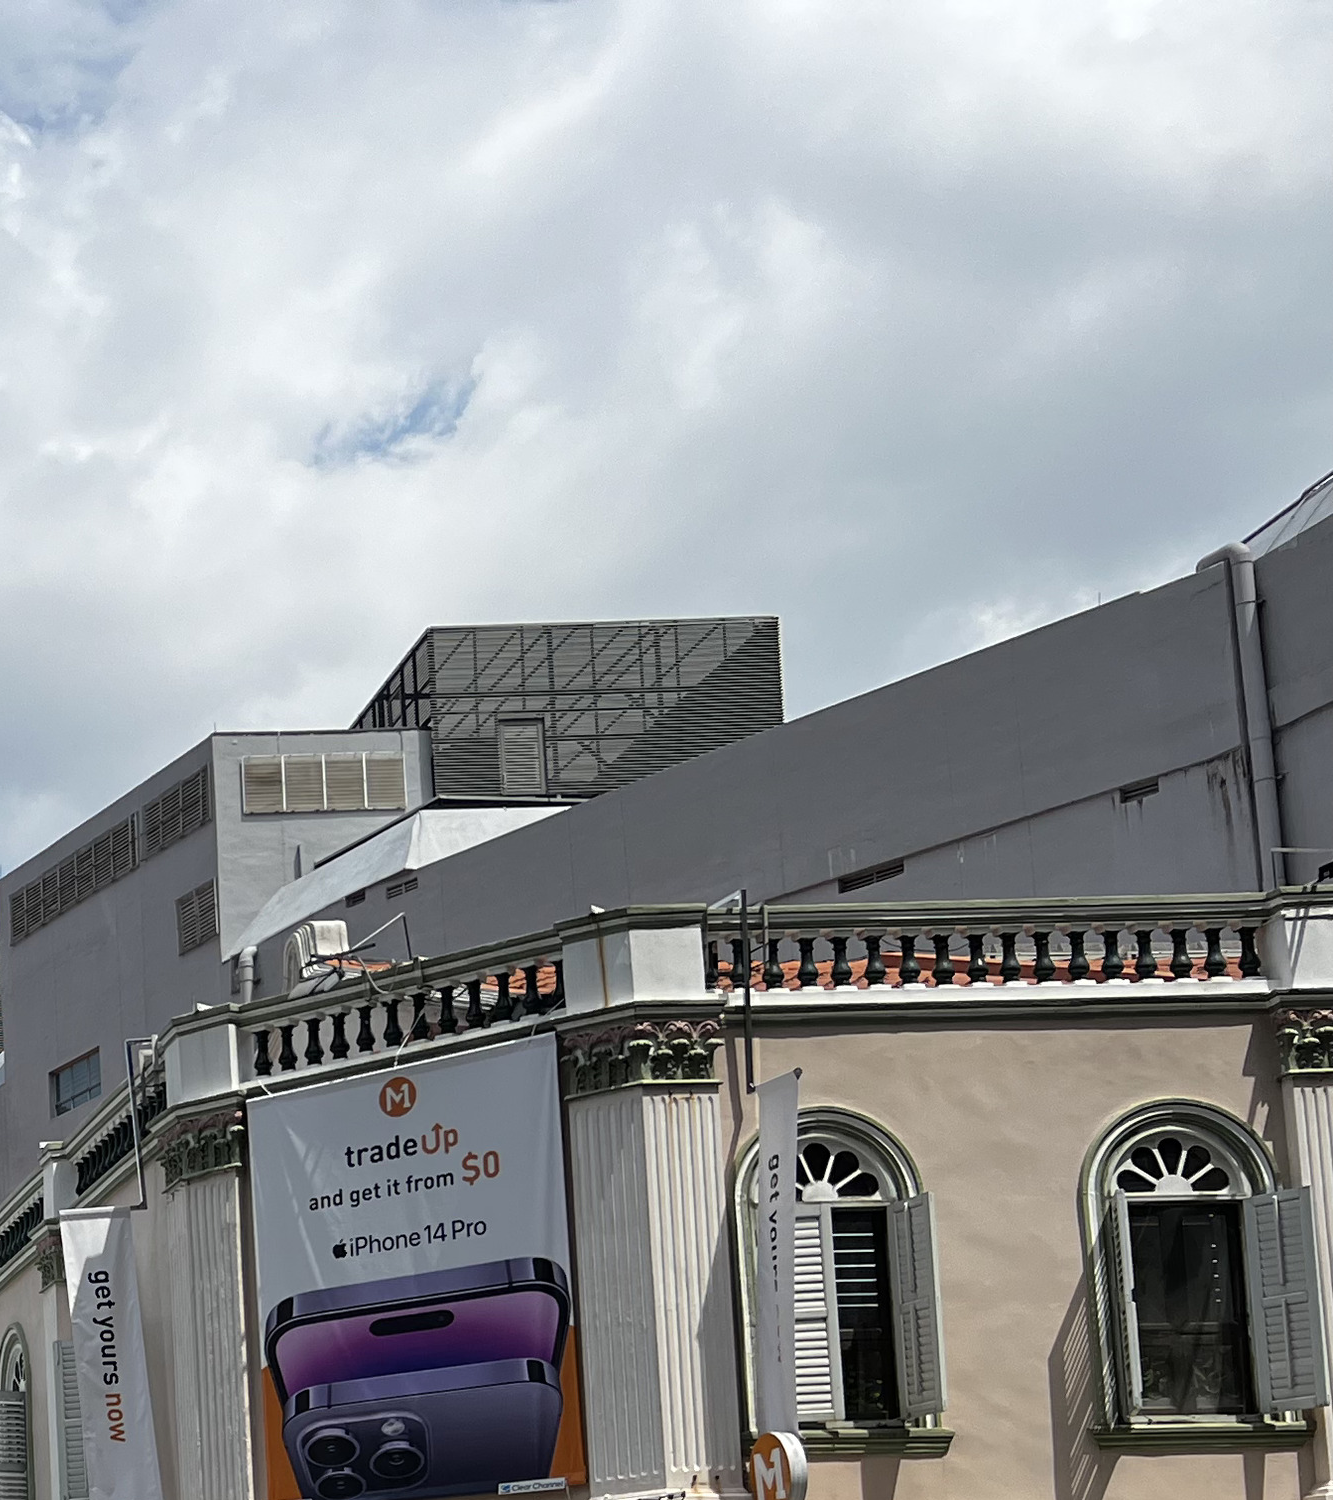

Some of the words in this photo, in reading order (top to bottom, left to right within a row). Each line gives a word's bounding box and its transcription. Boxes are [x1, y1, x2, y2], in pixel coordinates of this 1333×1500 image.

[385, 1083, 412, 1112] M1
[309, 1189, 344, 1211] and
[349, 1183, 381, 1208] get
[386, 1178, 401, 1197] it
[406, 1172, 455, 1194] from
[461, 1151, 500, 1186] $0
[349, 1231, 421, 1257] iPhone
[424, 1222, 447, 1244] 14
[452, 1219, 487, 1240] Pro
[88, 1270, 116, 1310] get
[93, 1316, 120, 1386] yours
[105, 1393, 126, 1442] now
[512, 1484, 531, 1492] Clear
[533, 1481, 564, 1490] Channel
